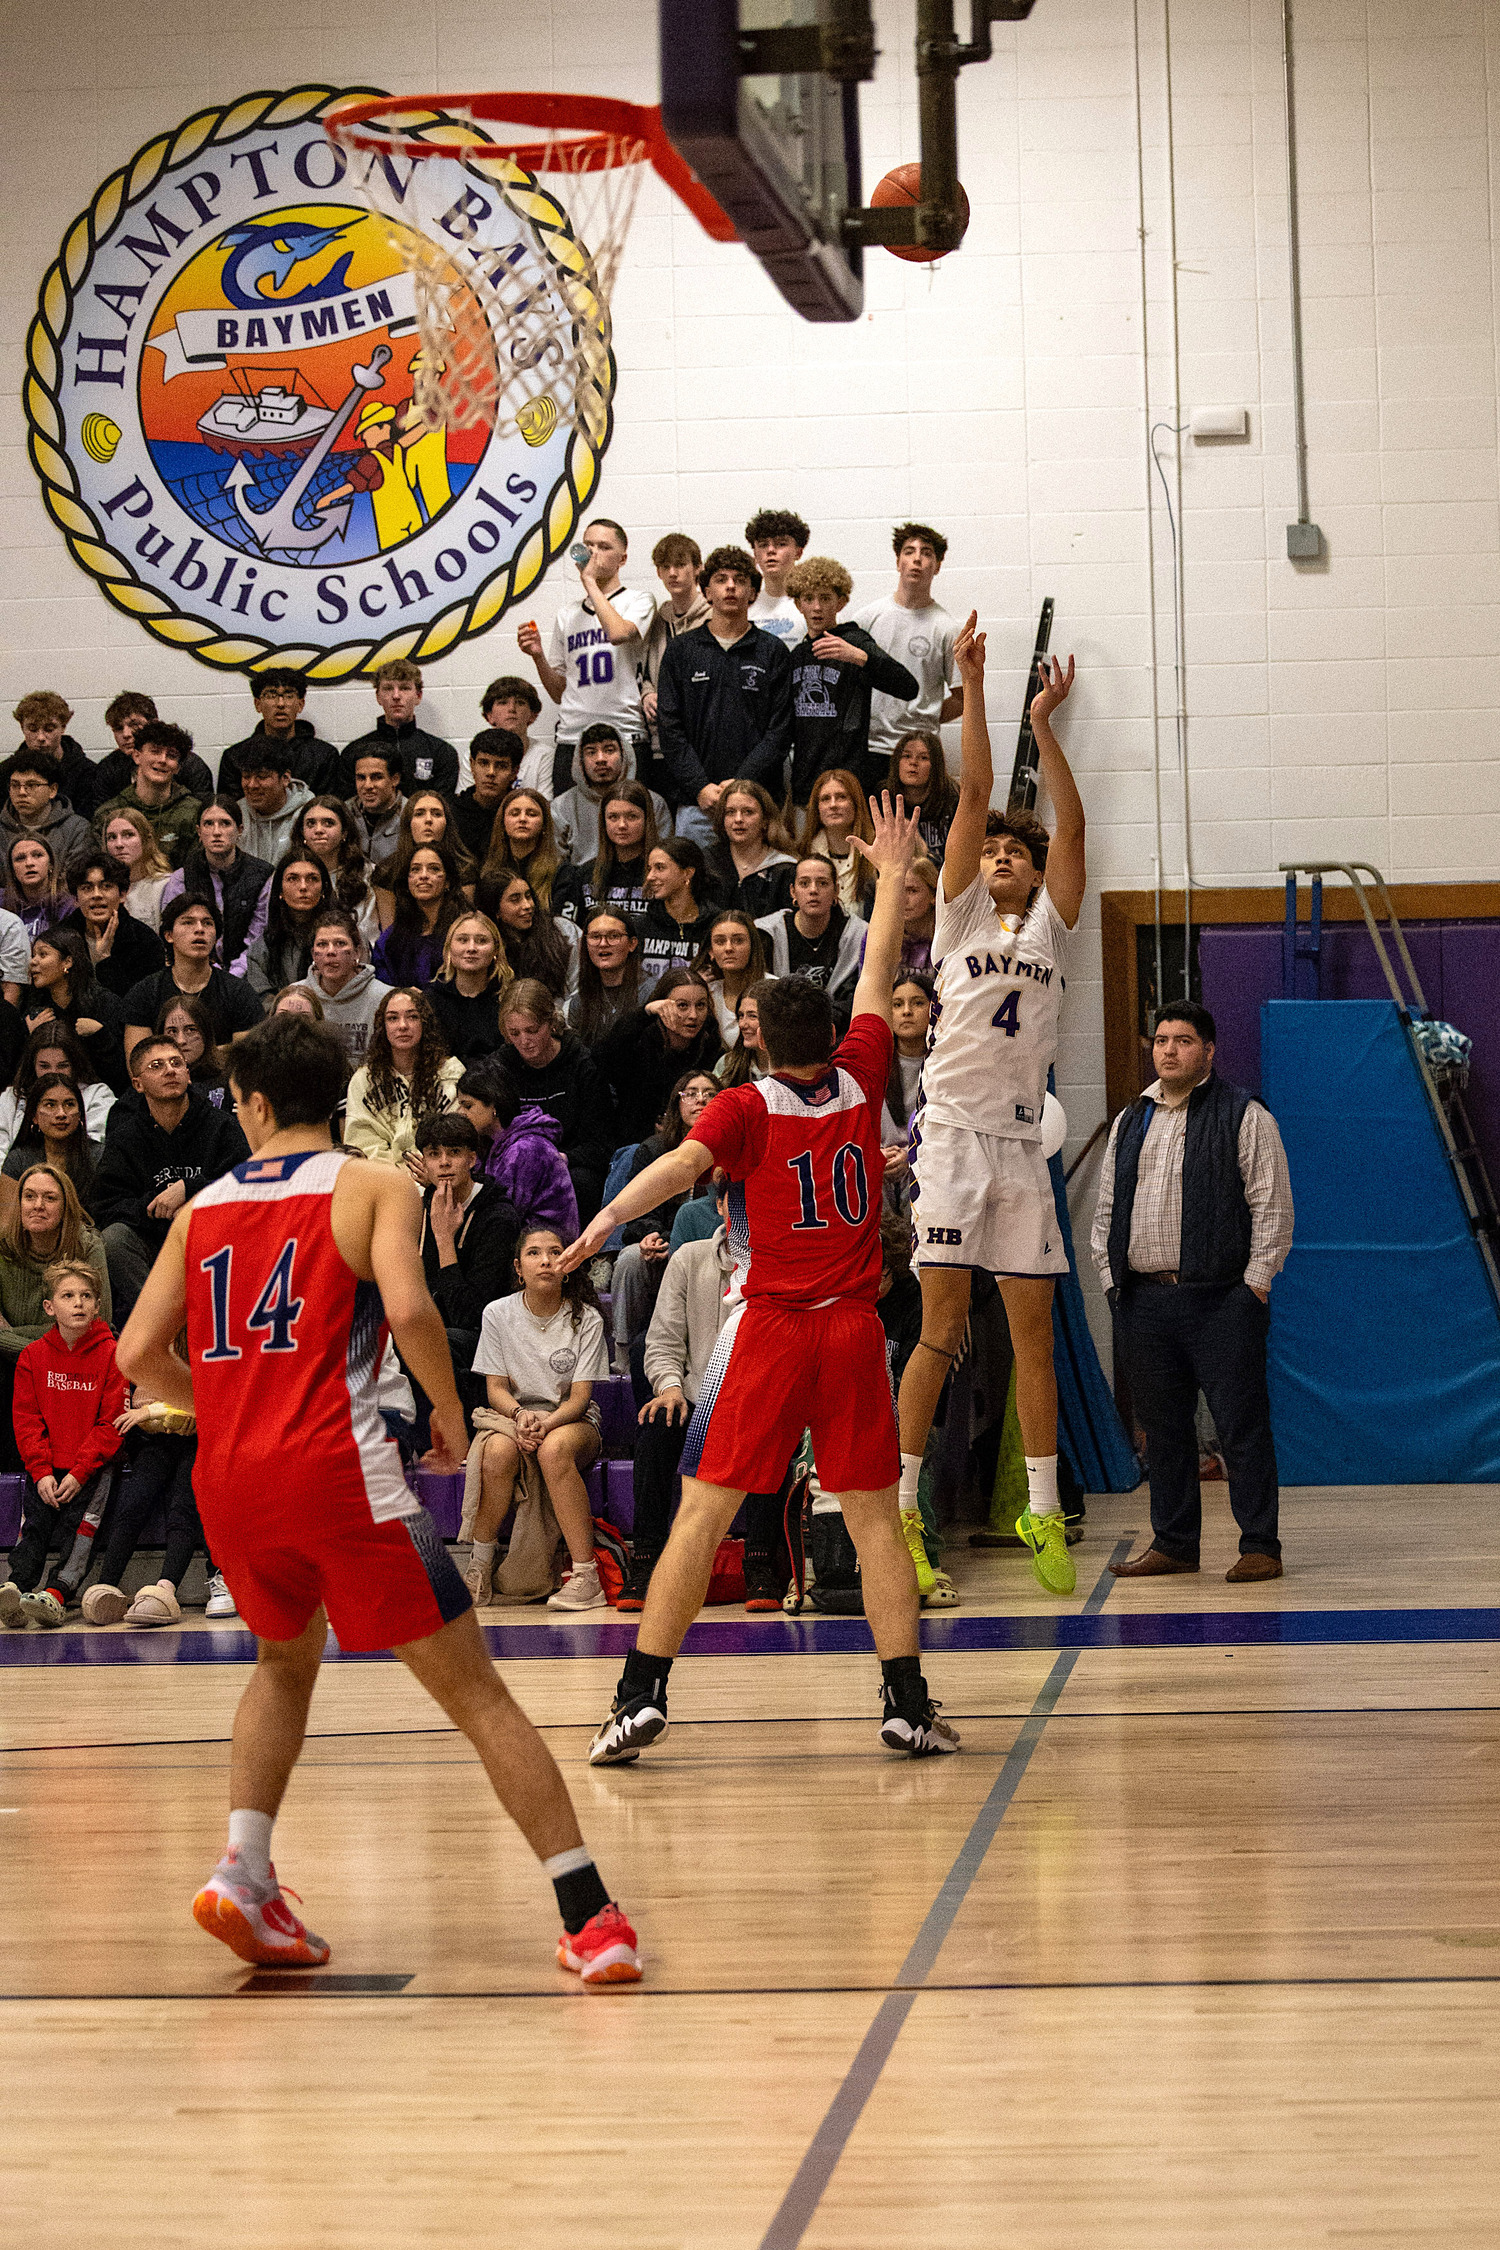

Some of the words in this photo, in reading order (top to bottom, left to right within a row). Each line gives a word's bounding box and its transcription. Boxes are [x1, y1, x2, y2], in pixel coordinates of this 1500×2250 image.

[74, 139, 425, 389] HAMPTON
[432, 183, 564, 370] BAYS
[216, 289, 395, 348] BAYMEN
[98, 474, 289, 622] Public
[316, 471, 538, 625] Schools
[567, 628, 611, 653] BAYM
[576, 651, 614, 688] 10
[965, 952, 1053, 988] BAYMEN
[990, 988, 1022, 1037] 4
[787, 1141, 870, 1231] 10
[926, 1227, 962, 1246] HB
[201, 1238, 305, 1363] 14
